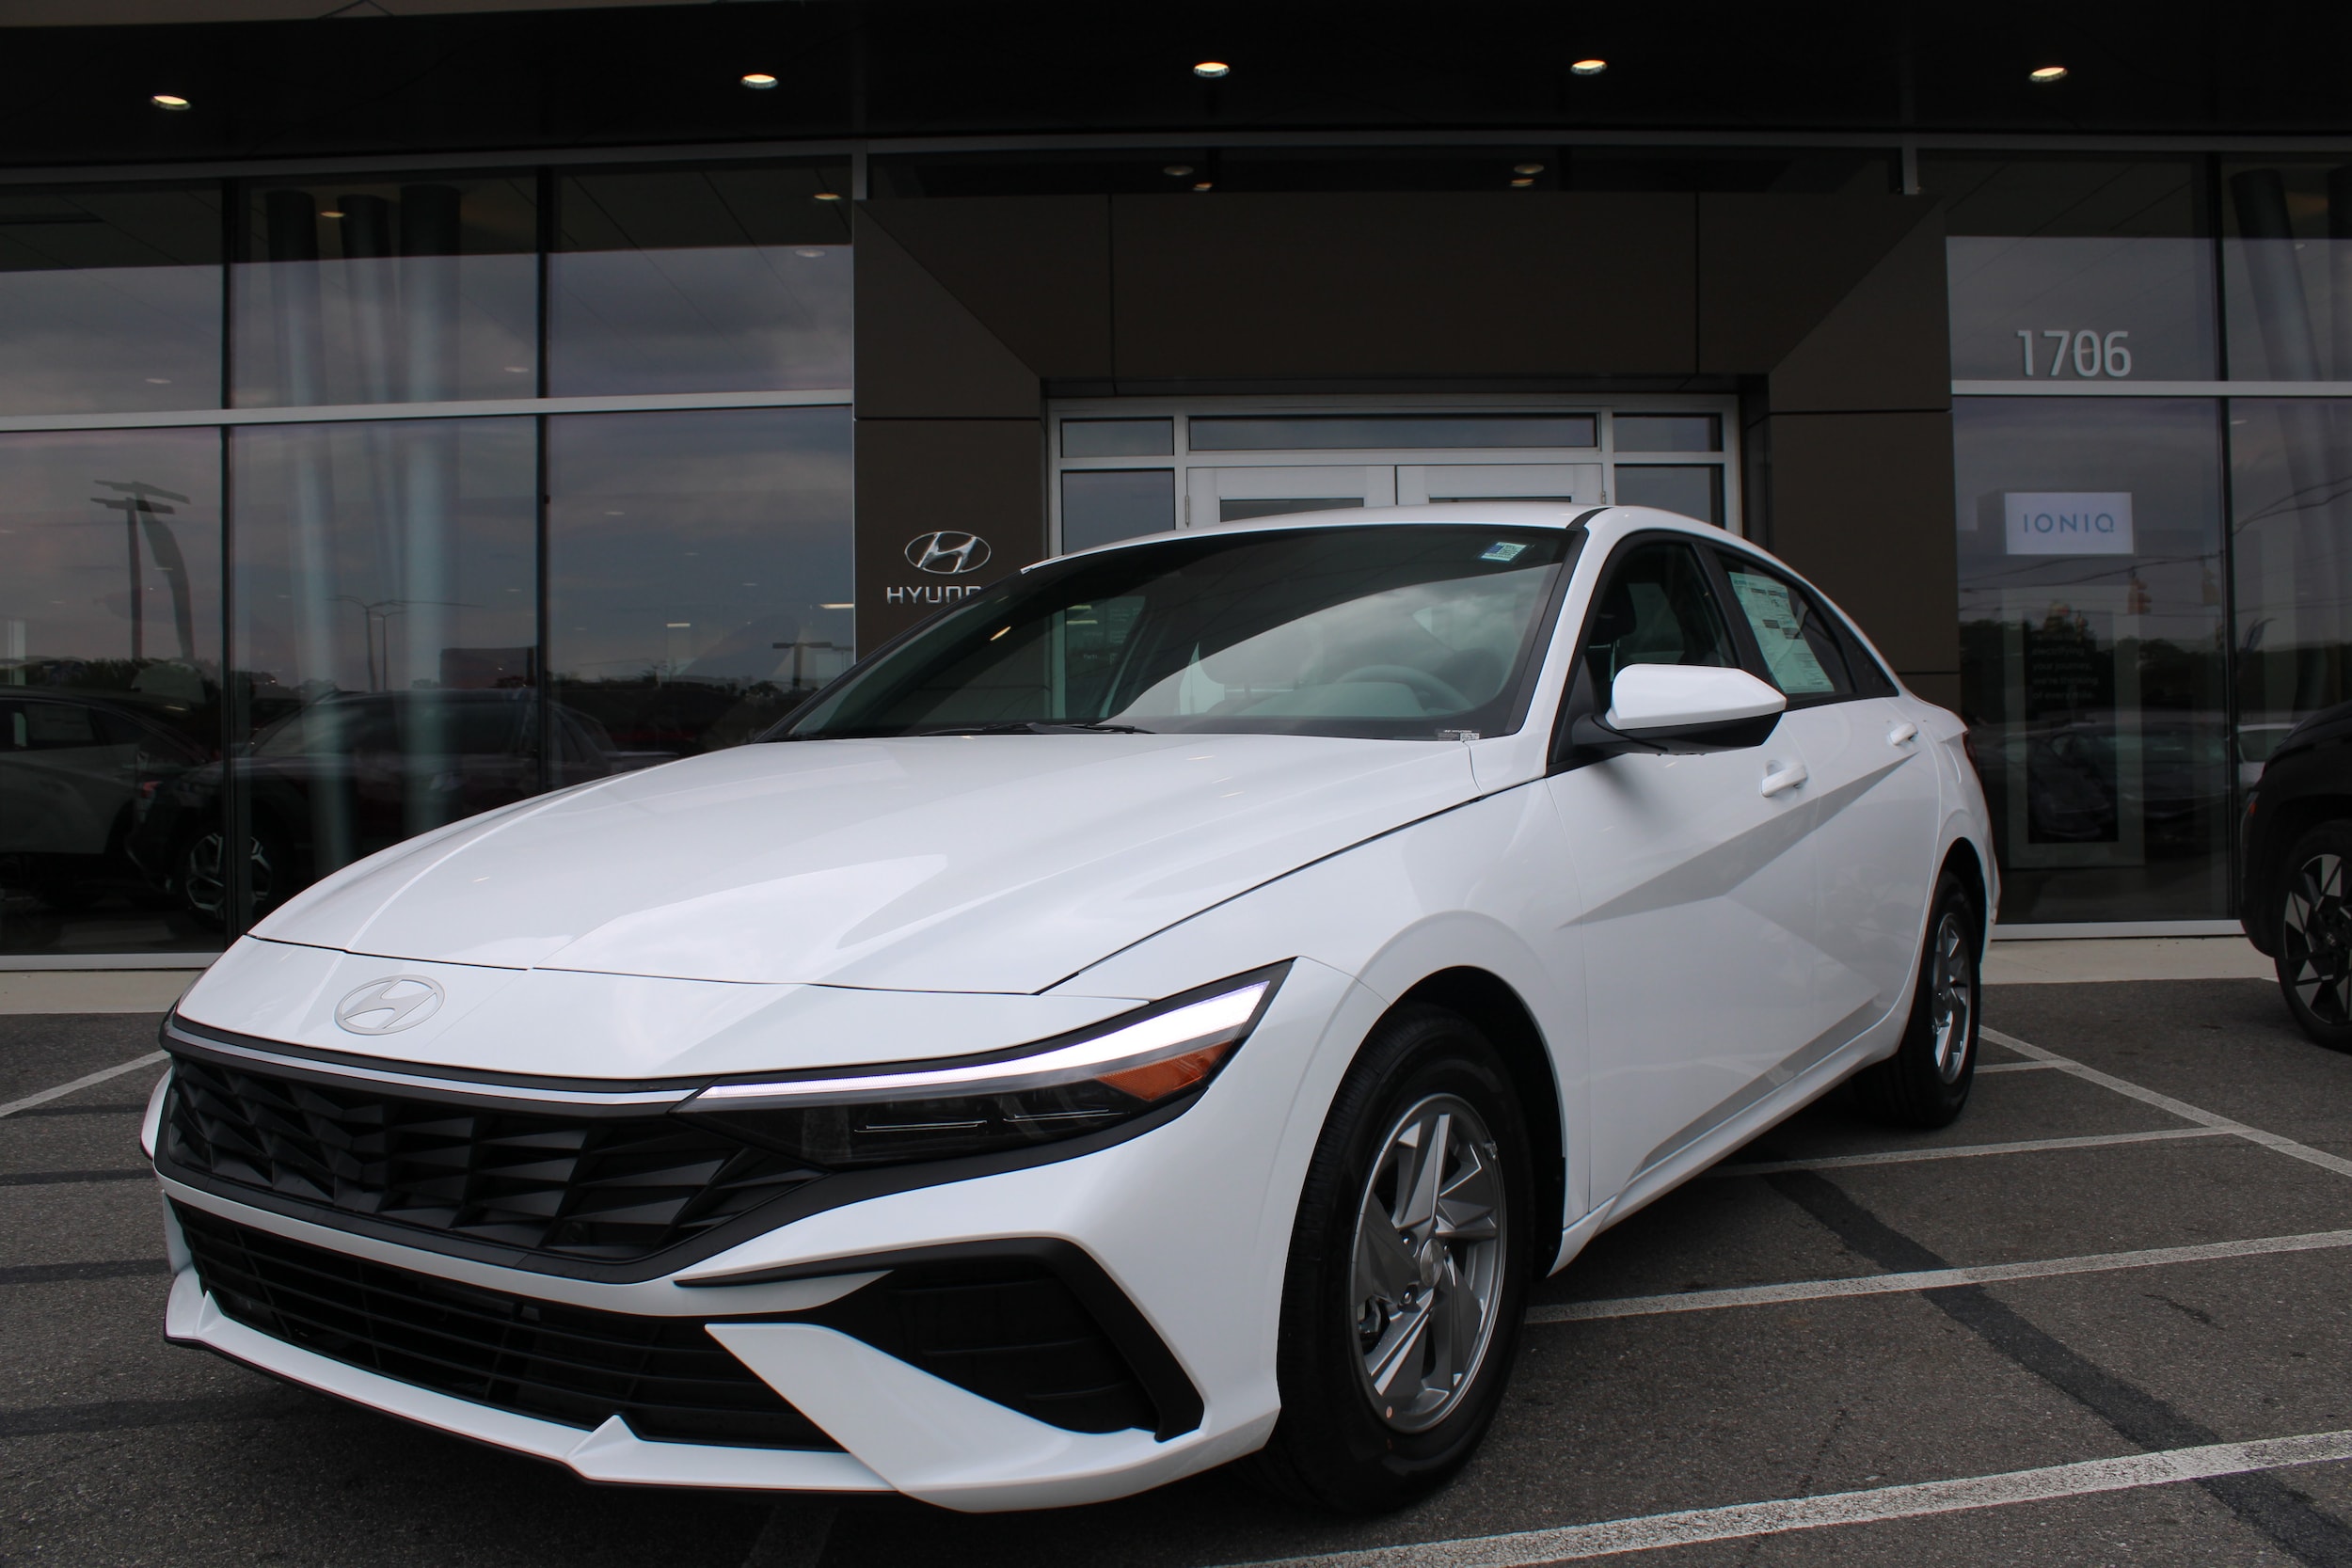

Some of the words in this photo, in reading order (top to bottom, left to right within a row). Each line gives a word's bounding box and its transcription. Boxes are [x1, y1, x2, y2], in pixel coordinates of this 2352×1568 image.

[2016, 329, 2132, 377] 1706
[2024, 513, 2114, 533] IONIQ
[2032, 662, 2053, 672] your
